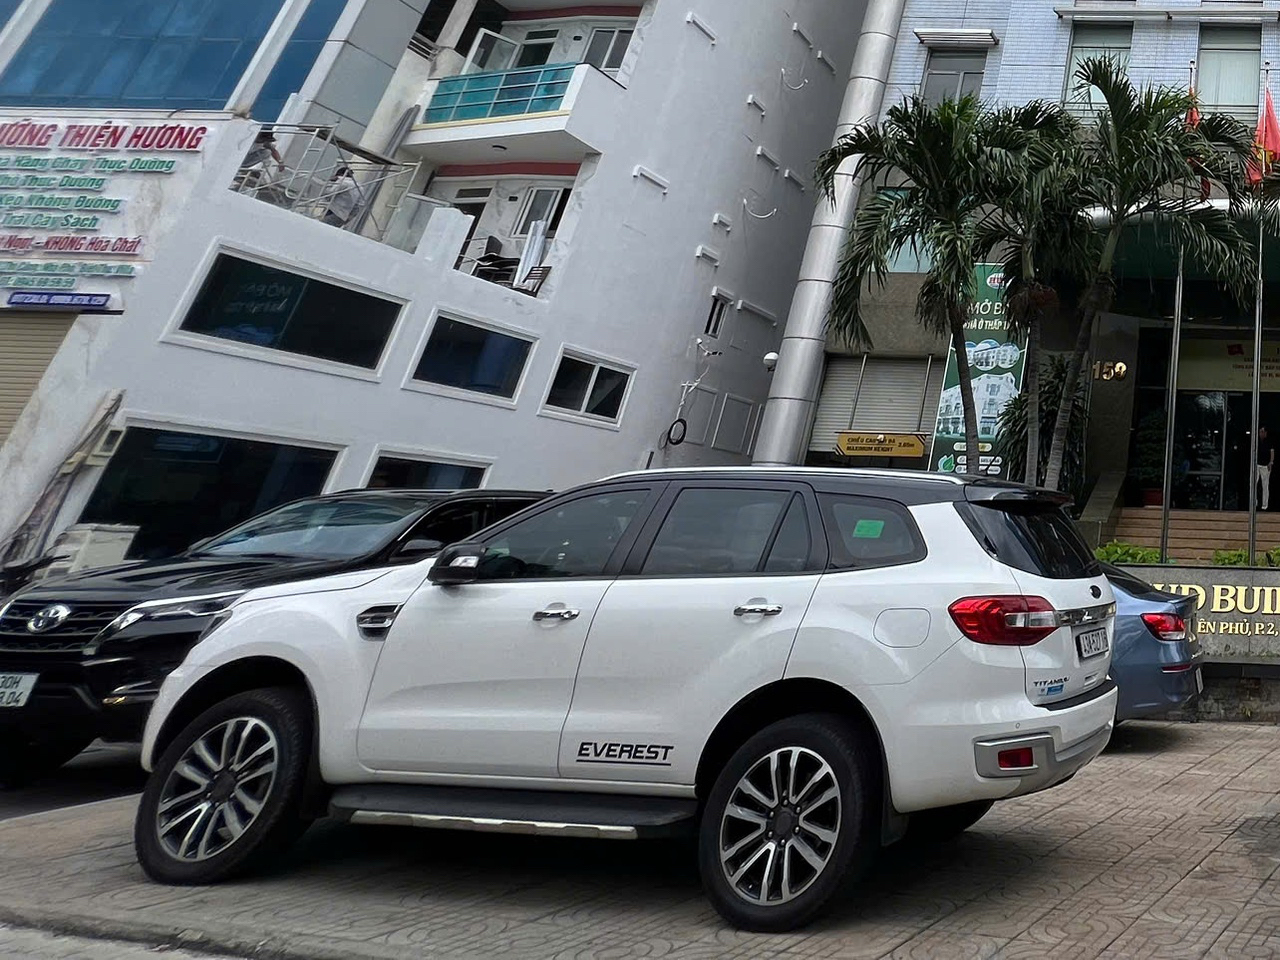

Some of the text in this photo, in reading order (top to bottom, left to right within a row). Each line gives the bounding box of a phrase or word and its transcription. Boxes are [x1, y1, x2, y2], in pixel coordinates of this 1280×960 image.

[0, 118, 207, 152] ƯỠNG THIỆN HƯƠNG
[1197, 619, 1215, 635] ÊN
[1219, 618, 1252, 637] PHỦ,
[577, 741, 674, 761] EVEREST
